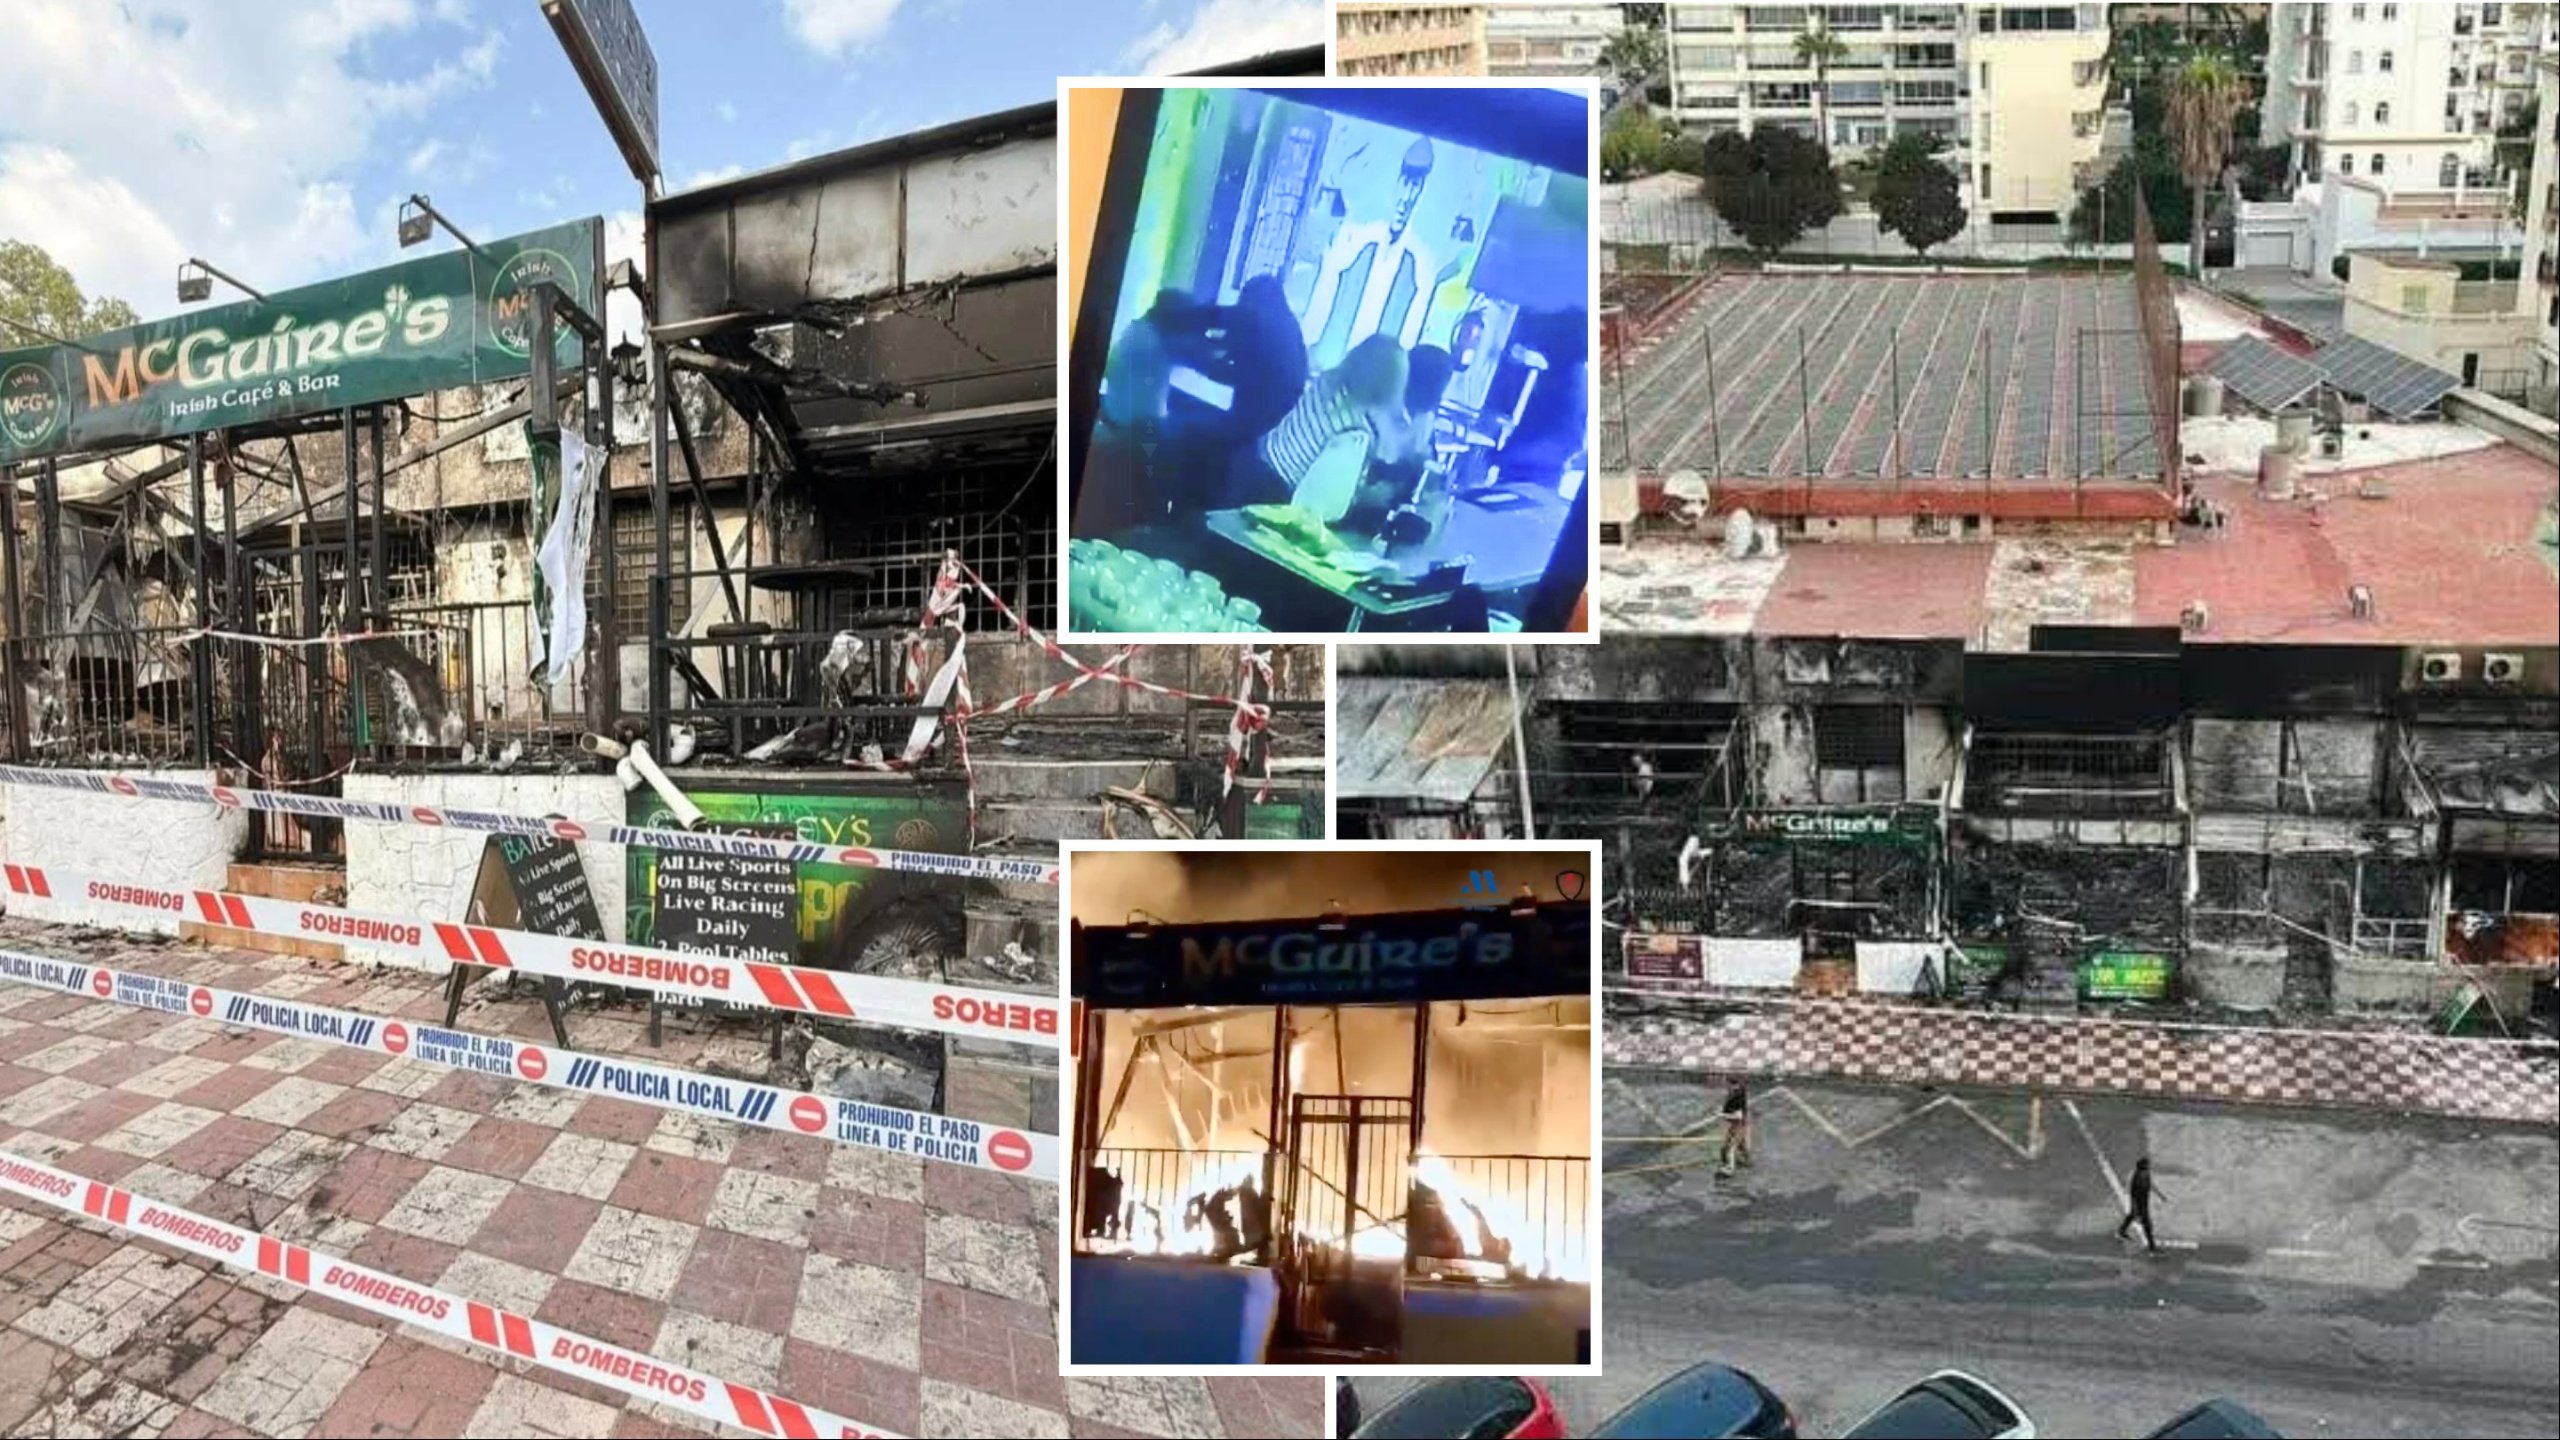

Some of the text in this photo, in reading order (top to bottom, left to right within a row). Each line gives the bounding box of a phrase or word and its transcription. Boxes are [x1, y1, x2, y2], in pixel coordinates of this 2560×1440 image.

[170, 373, 341, 417] Irish Café & Bar
[660, 855, 791, 876] All Live Sports
[891, 852, 1043, 876] PROHIBIDO EL PASO
[88, 881, 184, 911] BOMBEROS
[657, 877, 796, 897] On Big Screens
[664, 894, 785, 918] Live Racing
[300, 910, 421, 946] BOMBEROS
[696, 918, 751, 940] Daily
[572, 946, 730, 989] BOMBEROS
[726, 946, 790, 963] Tables
[35, 962, 65, 984] LOCAL
[117, 973, 189, 998] PROHIBIDO EL PASO
[155, 997, 188, 1012] POLICIA
[252, 1002, 345, 1039] POLICIA LOCAL
[933, 994, 1059, 1035] BEROS
[416, 1027, 514, 1059] PROHIBIDO EL PASO
[416, 1044, 513, 1075] LINEA DE POLICIA
[603, 1066, 734, 1113] POLICIA LOCAL
[838, 1102, 980, 1144] PROHIBIDO EL PASO
[838, 1122, 978, 1165] LINEA DE POLICIA
[138, 1206, 246, 1254] BOMBEROS
[323, 1266, 451, 1320] BOMBEROS
[551, 1337, 707, 1402] BOMBEROS
